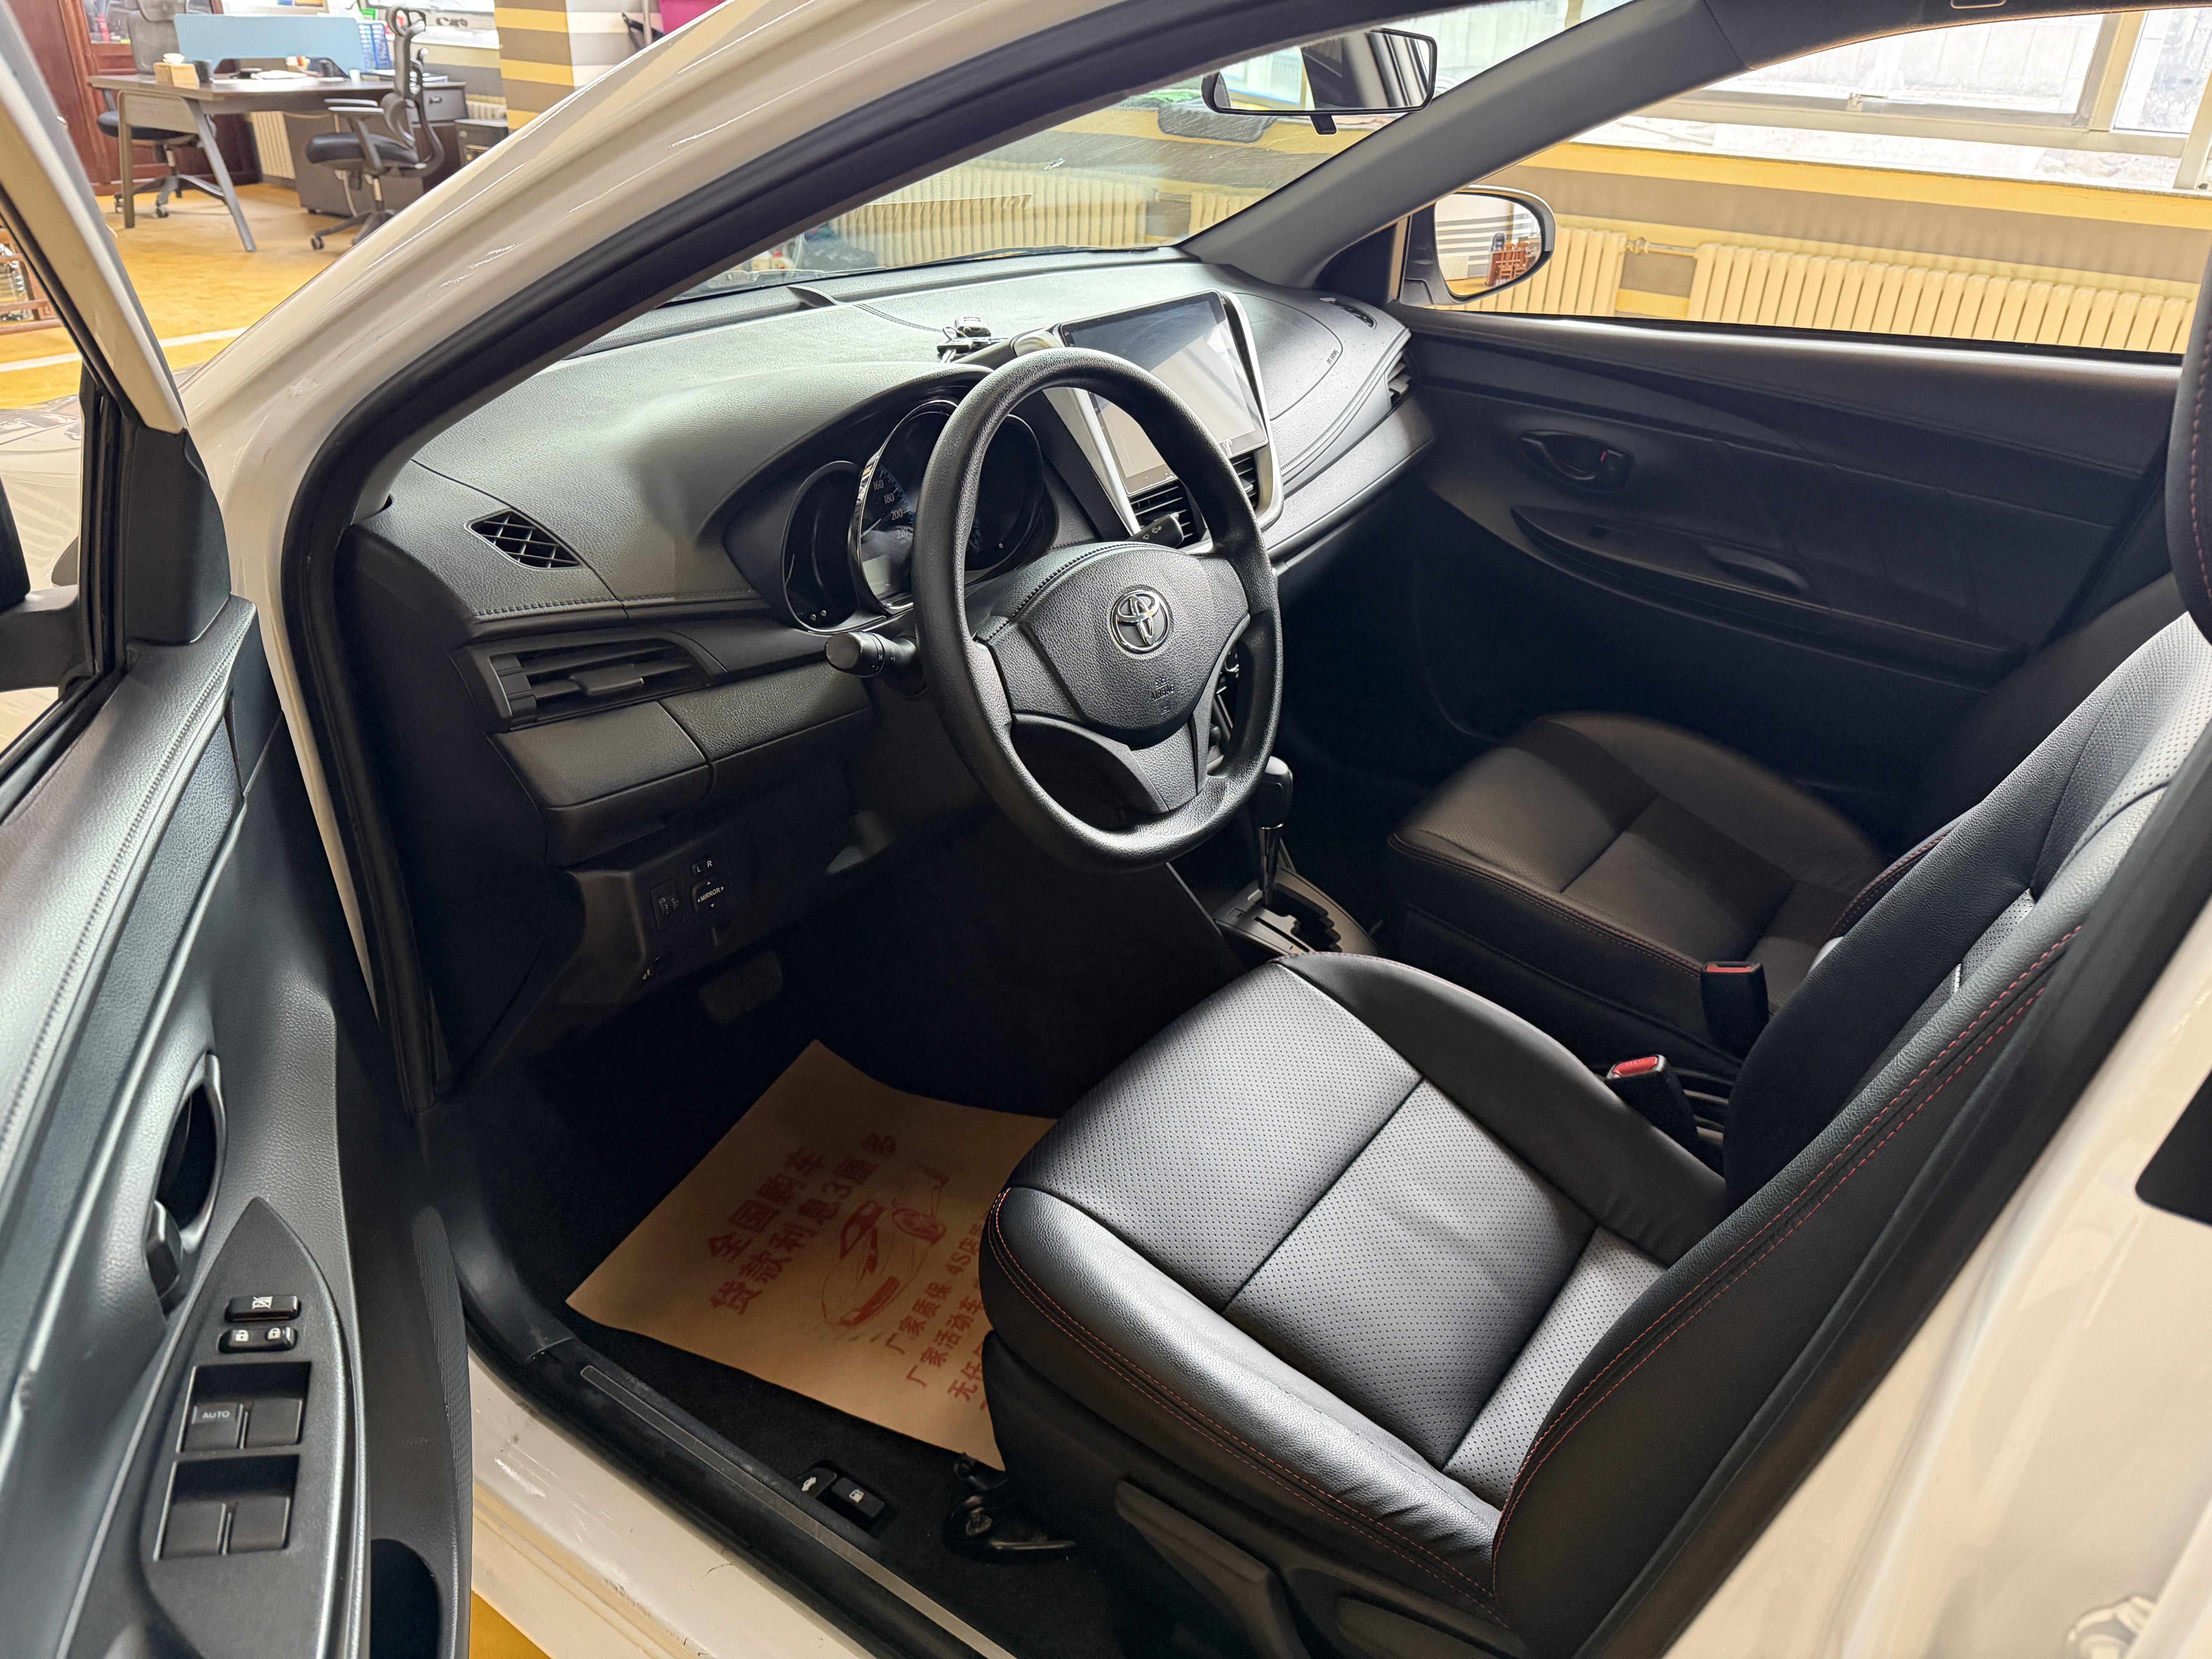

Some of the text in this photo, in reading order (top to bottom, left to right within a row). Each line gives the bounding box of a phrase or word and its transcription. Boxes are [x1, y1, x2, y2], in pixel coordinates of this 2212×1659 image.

[873, 479, 884, 491] 160
[884, 493, 894, 504] 180
[891, 508, 903, 520] 200
[897, 528, 908, 539] 220
[1151, 683, 1175, 701] AIRBAG
[700, 887, 721, 902] MIRROR
[708, 1146, 826, 1262] 全国购车
[710, 1132, 896, 1314] 贷款利息3厘多
[885, 1281, 952, 1355] 厂家质保
[906, 1279, 984, 1388] 厂家活动车
[948, 1340, 982, 1401] 无任
[202, 1411, 230, 1419] AUTO
